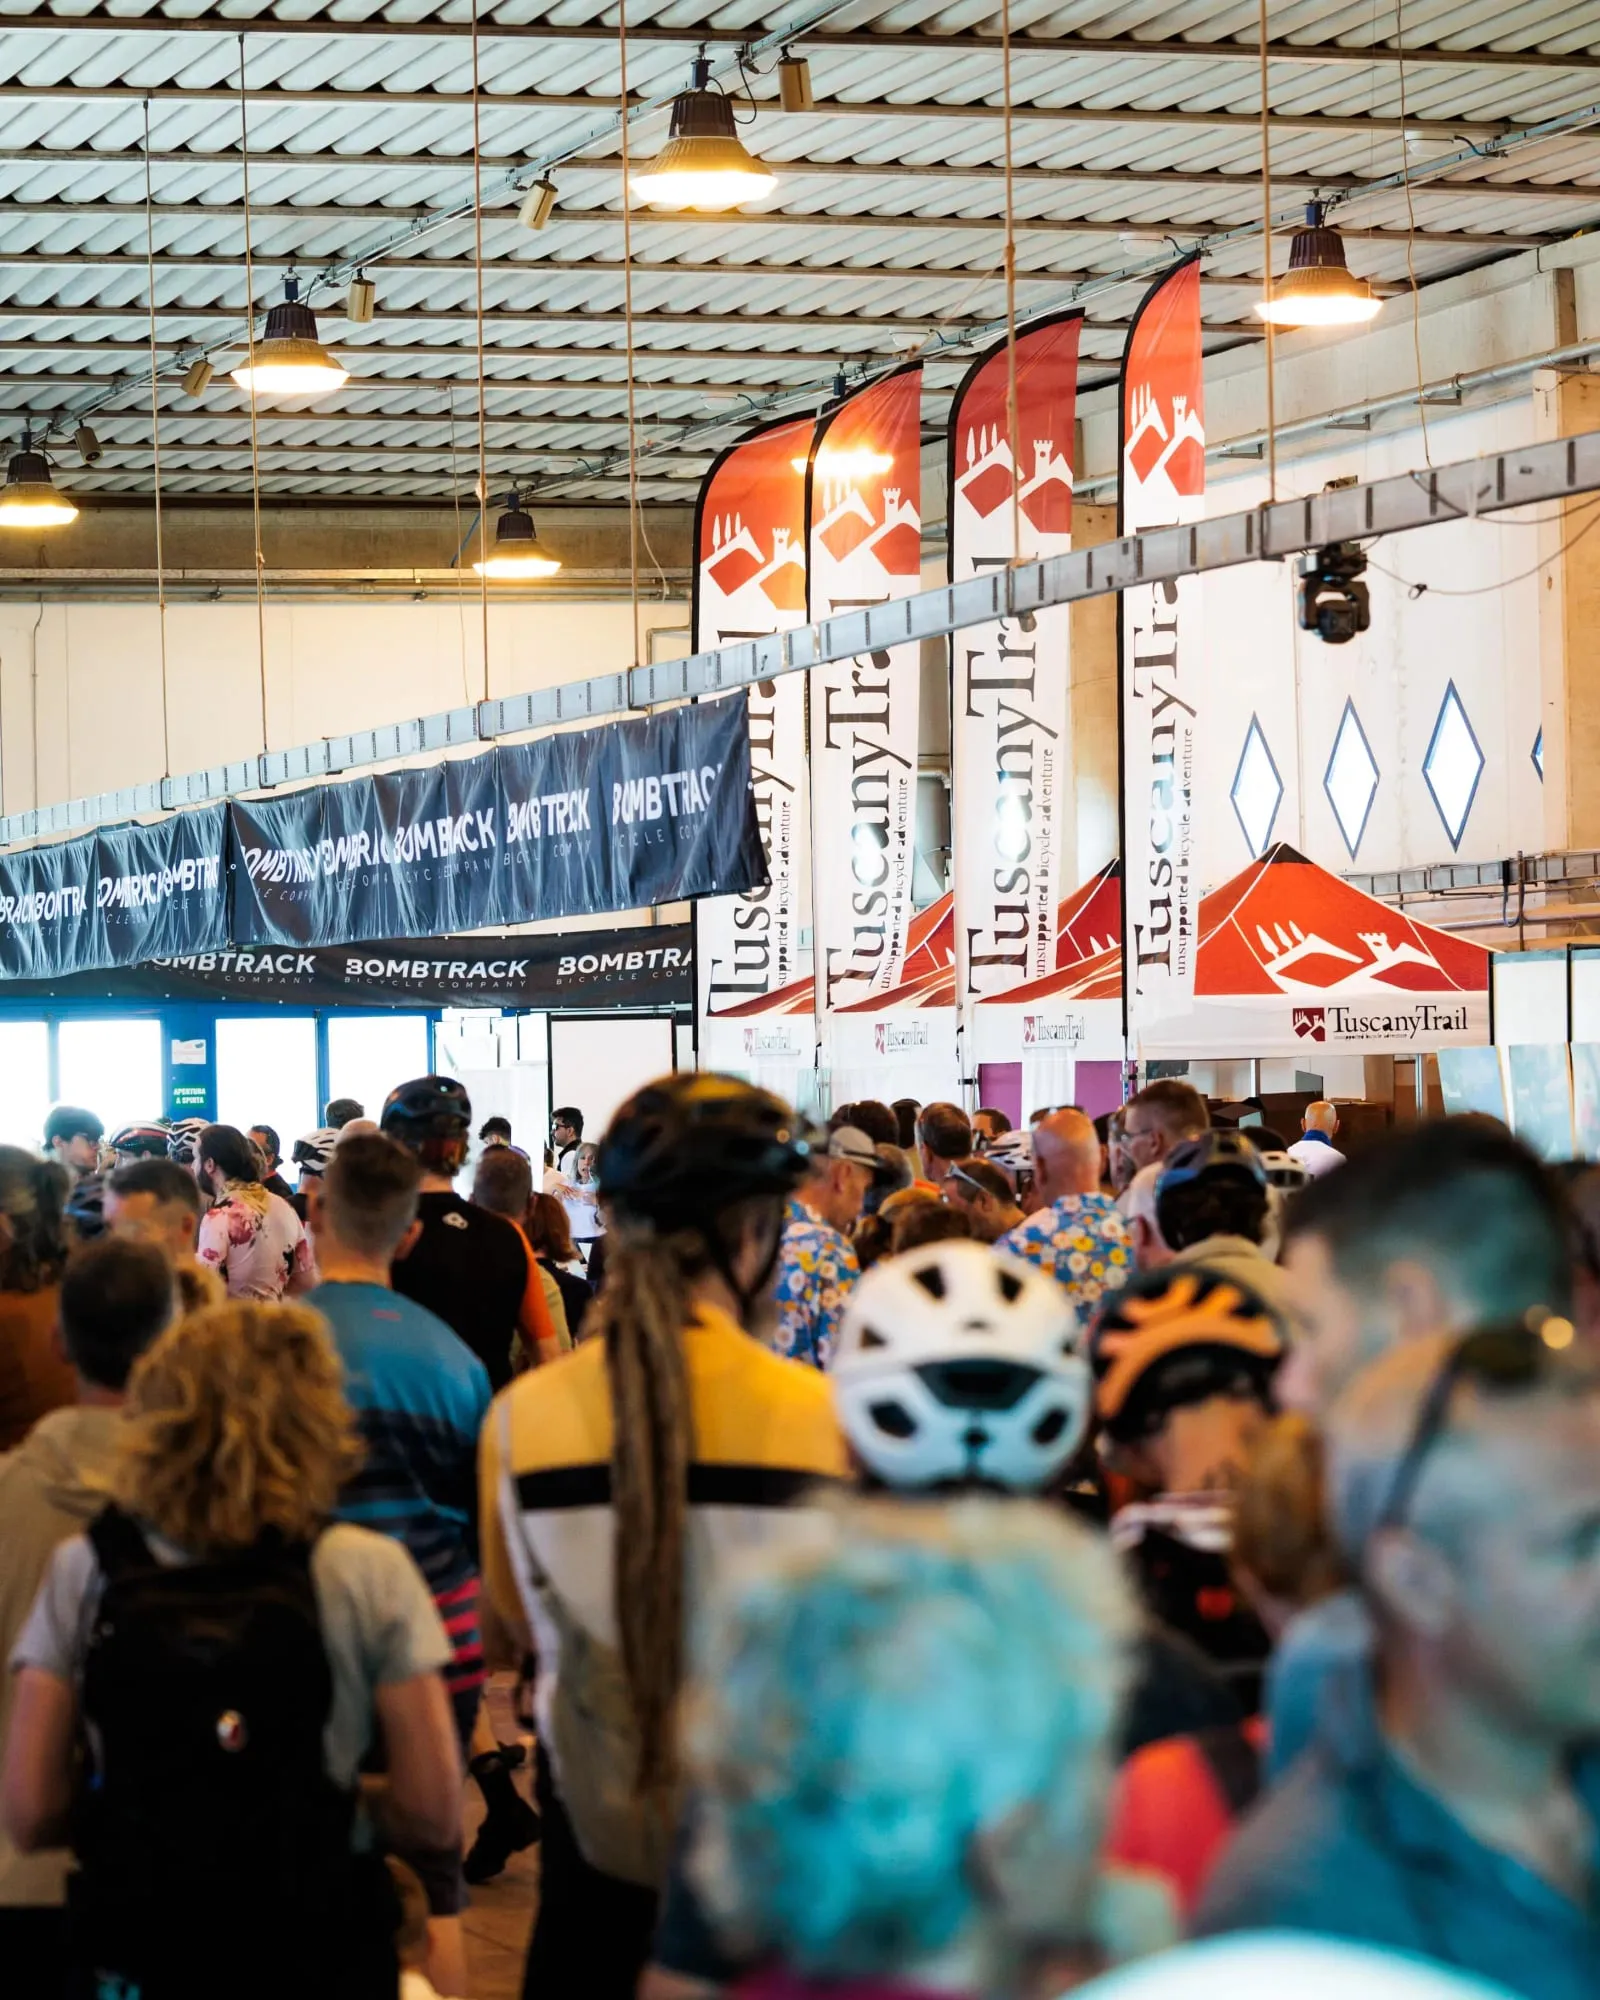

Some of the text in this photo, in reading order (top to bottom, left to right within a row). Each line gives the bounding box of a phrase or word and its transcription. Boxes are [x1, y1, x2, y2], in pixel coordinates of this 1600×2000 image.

[776, 801, 791, 865] adventure
[894, 777, 908, 846] adventure
[1035, 748, 1055, 977] unsupported bicycle adventure
[1176, 728, 1195, 976] unsupported bicycle adventure
[775, 871, 792, 915] bicycle
[892, 852, 907, 899] bicycle
[225, 975, 315, 985] COMPANY
[344, 976, 527, 989] BICYCLE COMPANY
[345, 958, 530, 979] BOMBTRACK
[556, 973, 637, 986] BICYCLE
[1328, 1005, 1469, 1039] TuscanyTrail
